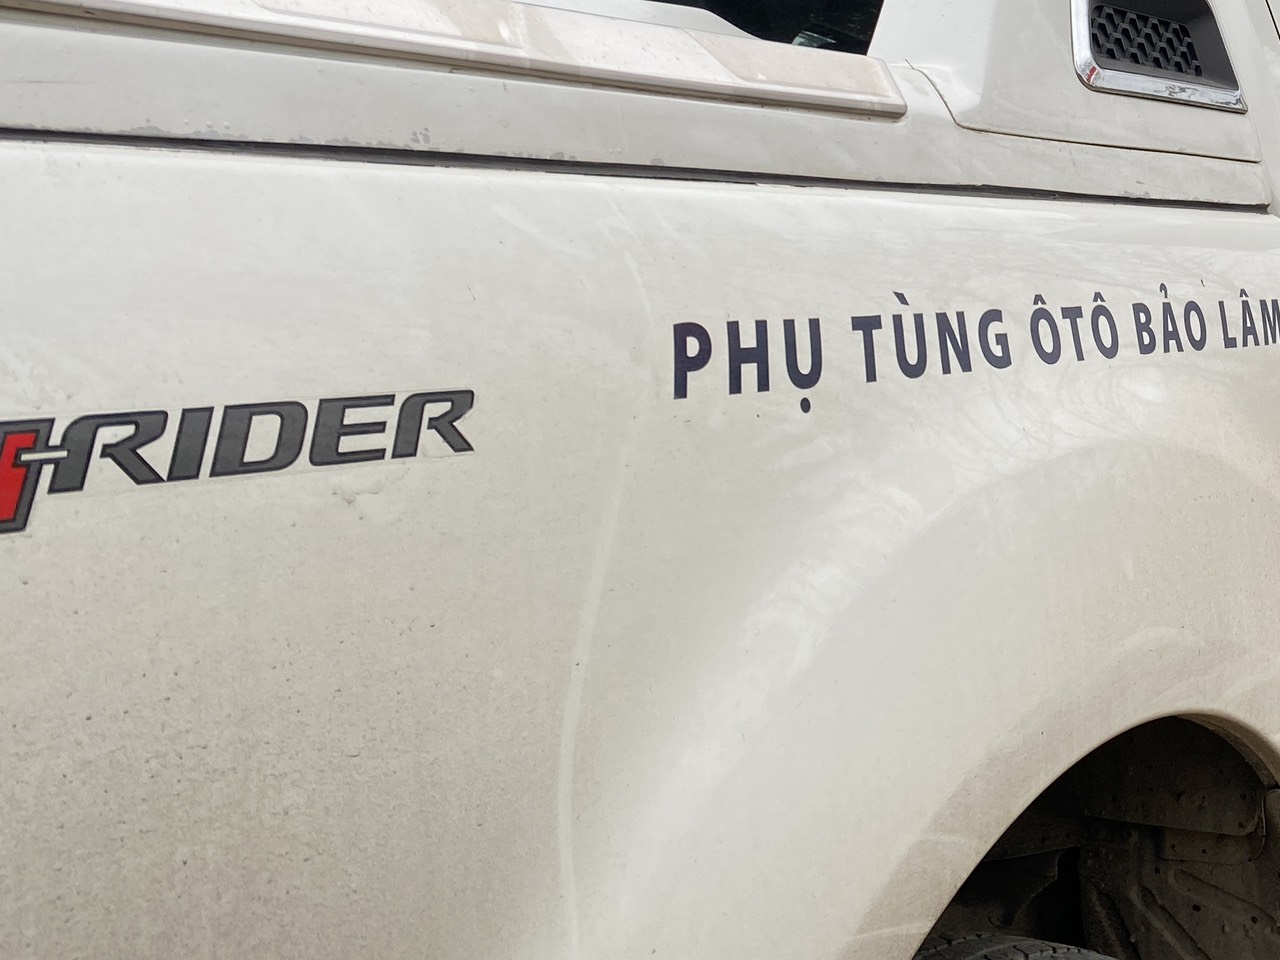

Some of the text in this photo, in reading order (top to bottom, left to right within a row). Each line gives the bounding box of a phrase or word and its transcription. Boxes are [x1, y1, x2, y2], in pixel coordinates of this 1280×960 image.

[672, 317, 823, 414] PHỤ
[851, 290, 1013, 383] TÙNG
[1030, 291, 1119, 365] ÔTÔ
[1132, 282, 1208, 355] BẢO
